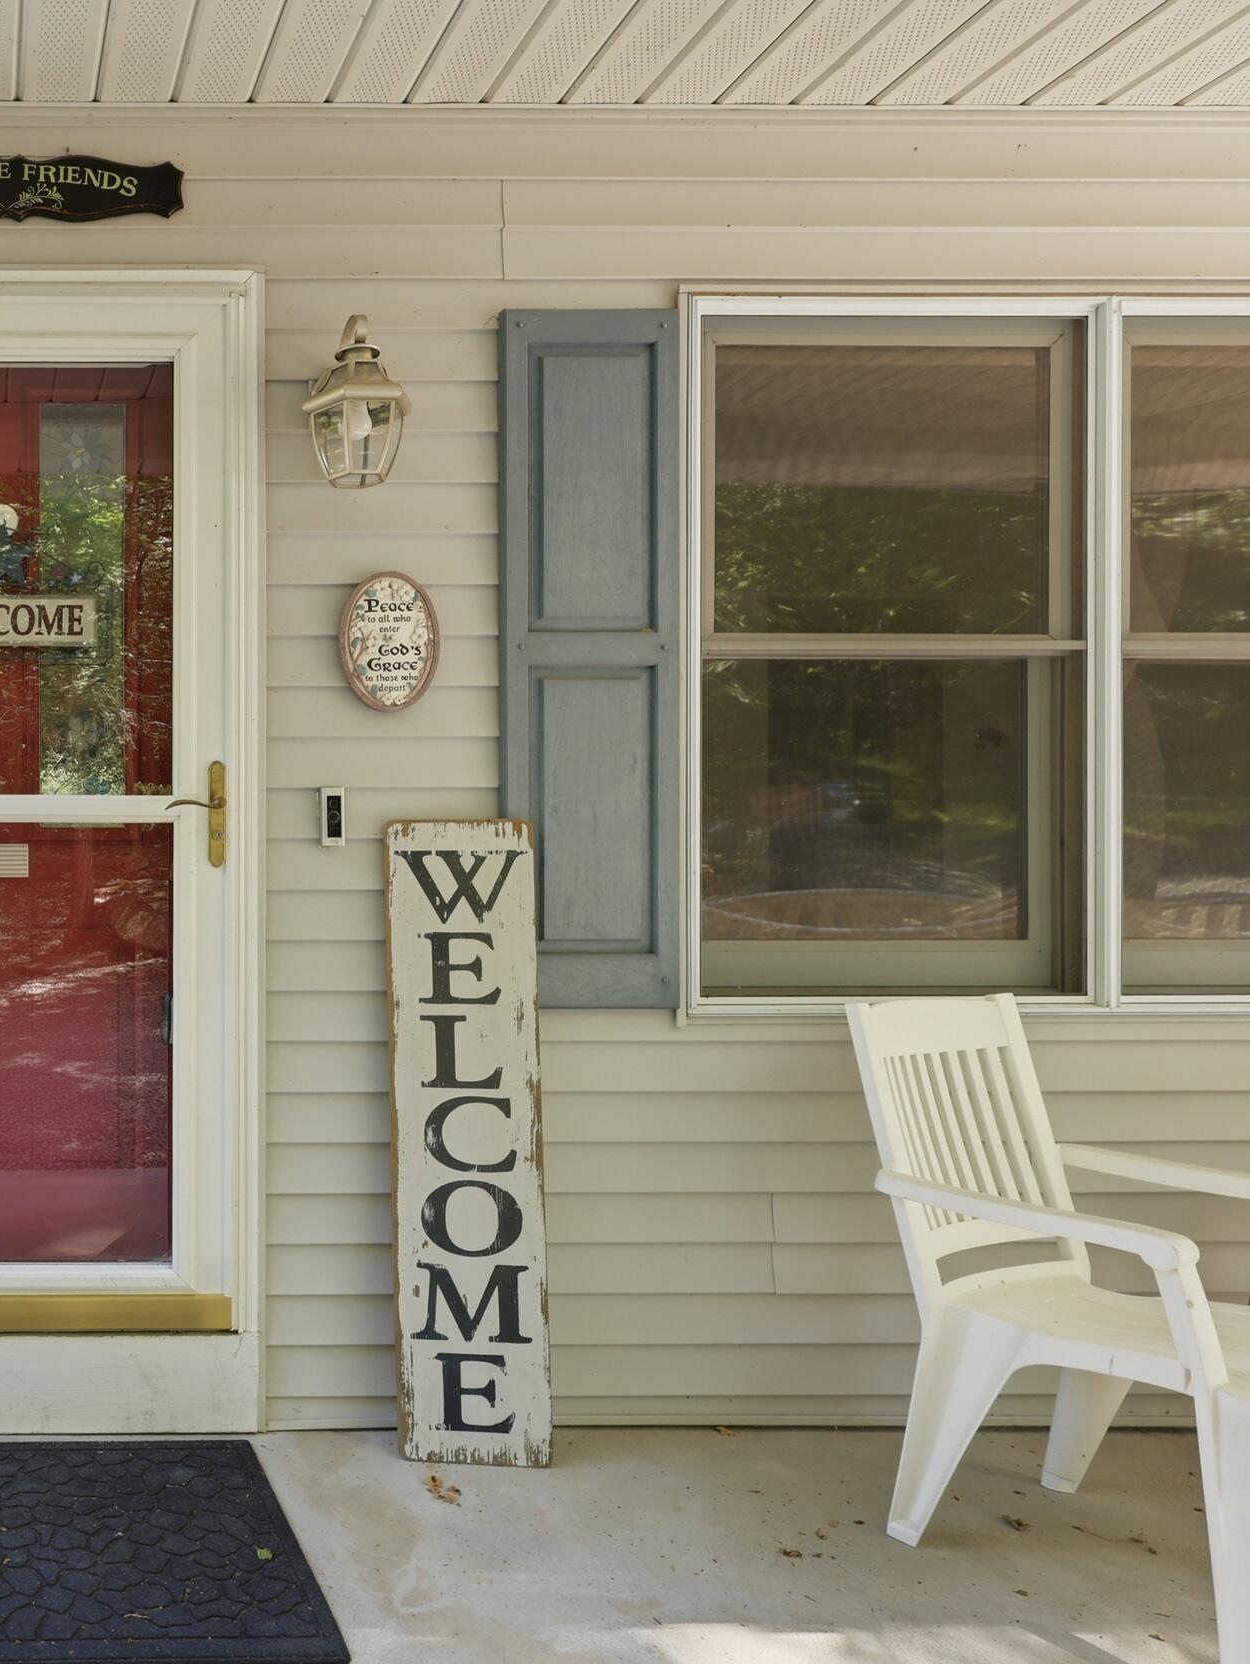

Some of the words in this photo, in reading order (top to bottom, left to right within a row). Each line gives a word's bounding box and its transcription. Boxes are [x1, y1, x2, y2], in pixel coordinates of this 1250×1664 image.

[21, 163, 138, 197] FRIENDS
[363, 599, 415, 613] Peace
[378, 614, 391, 623] all
[393, 614, 412, 623] who
[379, 625, 401, 633] enter
[376, 674, 399, 682] those
[401, 673, 419, 681] who
[378, 684, 406, 693] depart
[393, 849, 533, 1434] WELCOME
